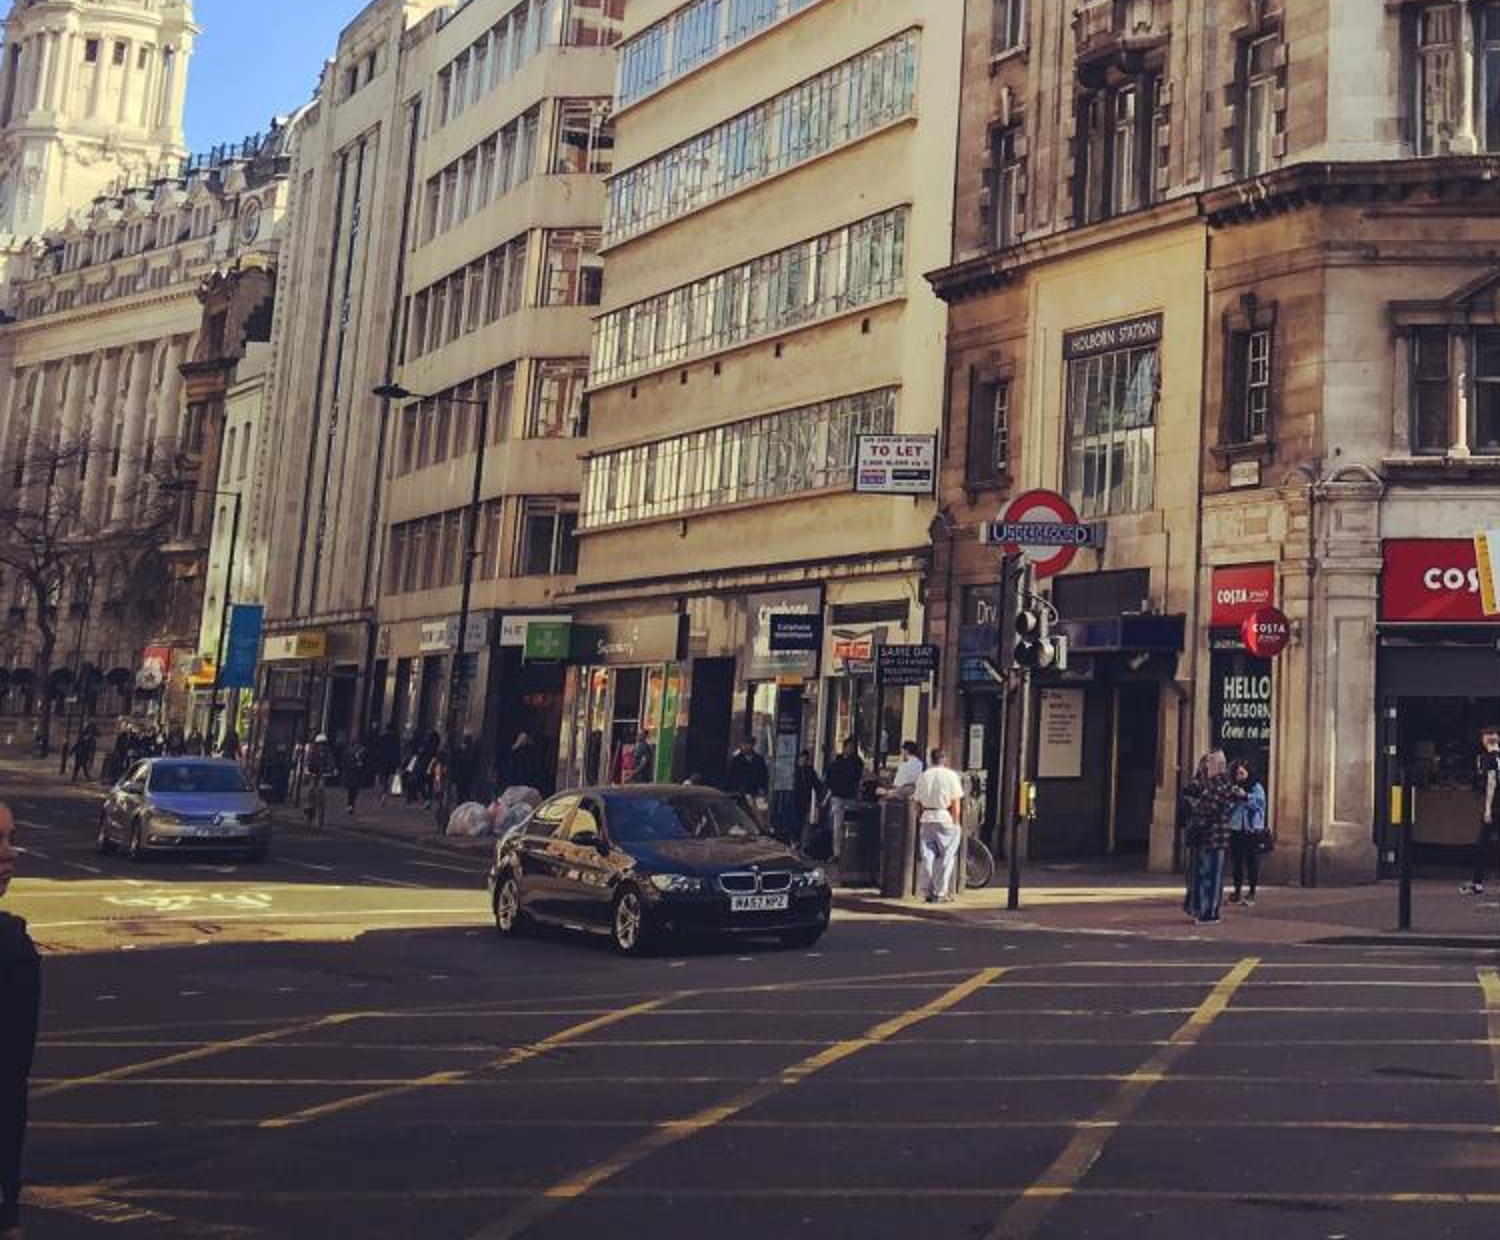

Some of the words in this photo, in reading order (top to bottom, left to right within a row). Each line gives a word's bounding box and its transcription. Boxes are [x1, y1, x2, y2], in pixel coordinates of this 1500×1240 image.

[1071, 330, 1115, 352] HOLBORN
[1119, 320, 1157, 343] STATION
[870, 445, 890, 457] TO
[896, 445, 924, 457] LET
[1423, 567, 1480, 593] COS
[1217, 587, 1248, 606] COSTA
[1252, 623, 1286, 634] COSTA
[880, 646, 910, 657] SAME
[1223, 675, 1271, 700] HELLO
